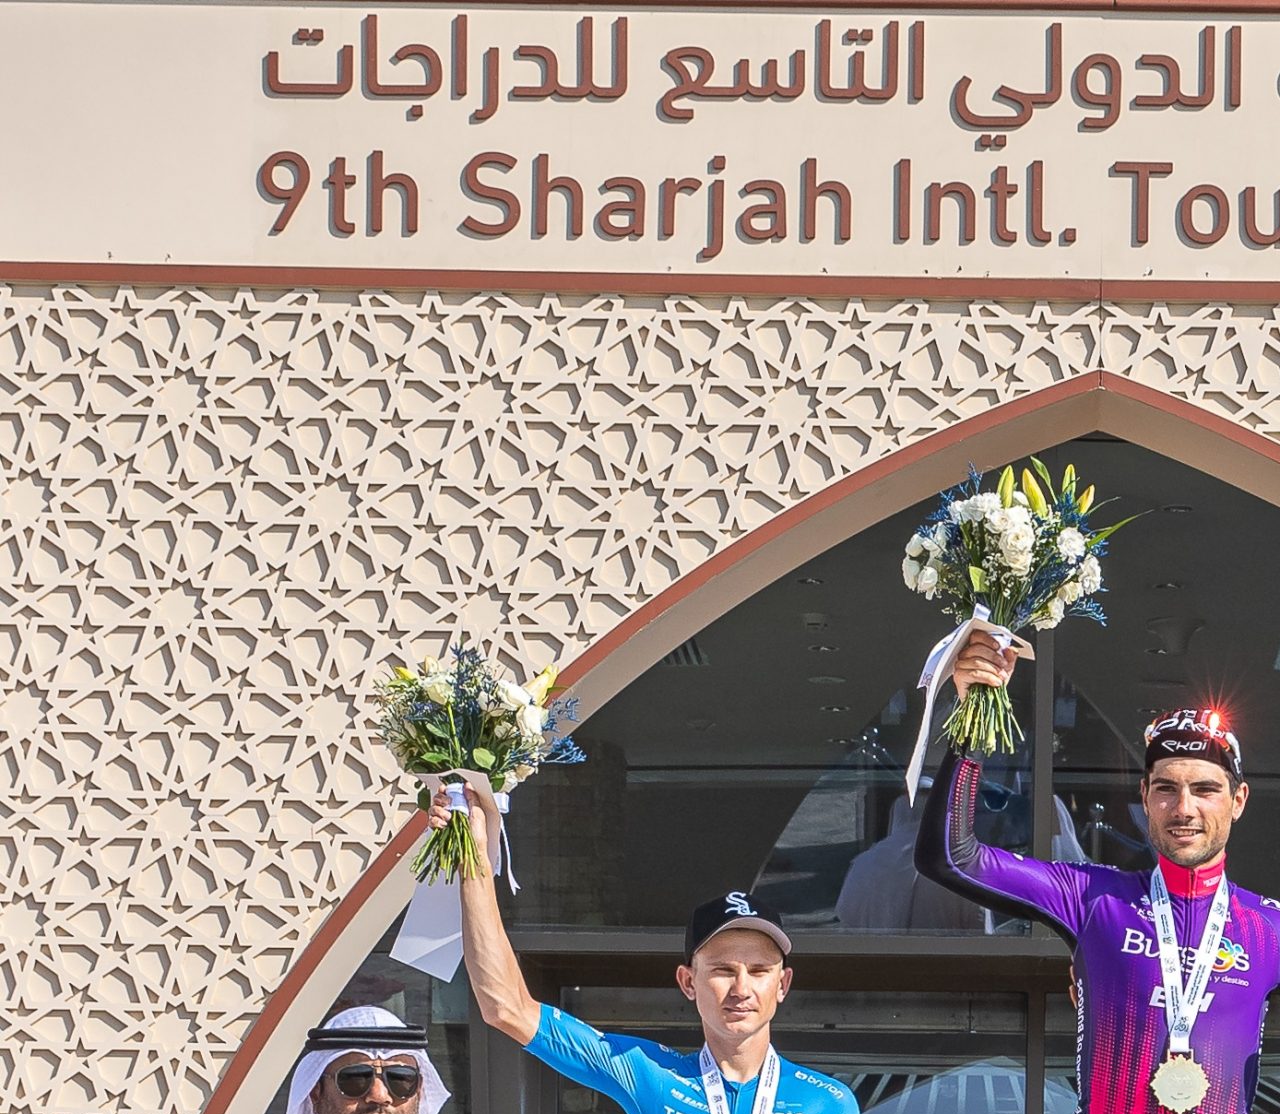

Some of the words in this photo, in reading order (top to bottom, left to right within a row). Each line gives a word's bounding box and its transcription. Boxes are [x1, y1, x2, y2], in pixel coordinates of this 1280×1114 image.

[263, 13, 628, 126] للدراجات
[657, 18, 925, 124] التاسع
[951, 22, 1242, 151] الدولي
[258, 150, 419, 236] 9th
[460, 151, 852, 262] Sharjah
[895, 158, 1077, 245] Intl.
[1121, 927, 1250, 973] Bugos
[1076, 978, 1085, 1033] BURGOS
[807, 1075, 844, 1099] bryton
